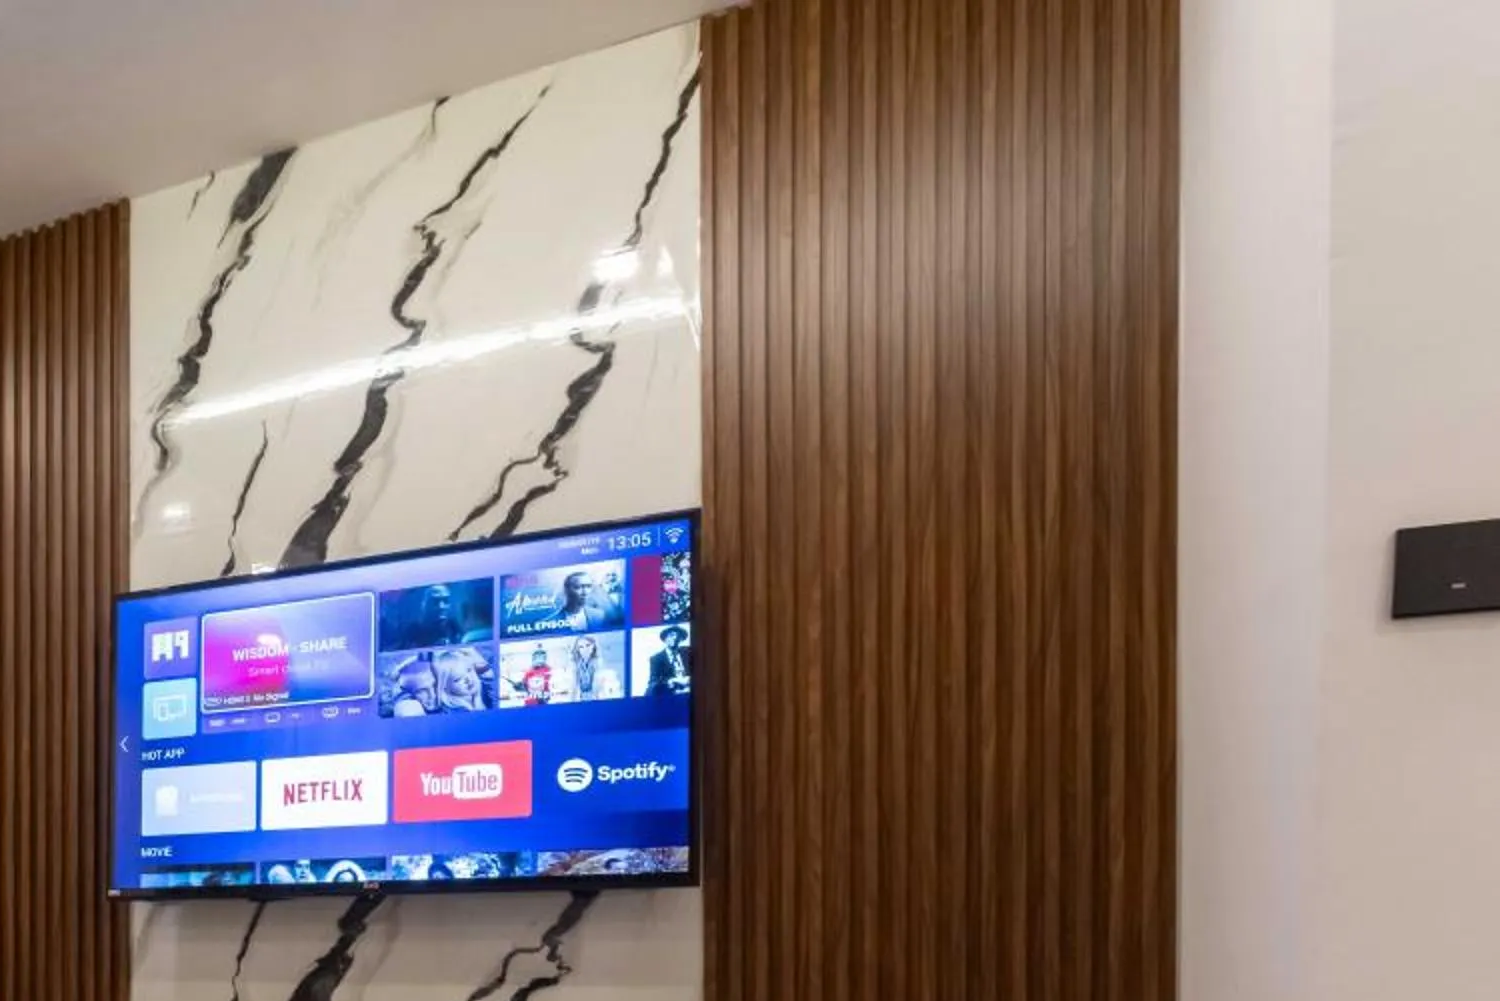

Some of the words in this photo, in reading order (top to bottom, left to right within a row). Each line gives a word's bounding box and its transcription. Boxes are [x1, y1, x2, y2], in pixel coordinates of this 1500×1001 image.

[607, 531, 652, 551] 13:05
[507, 622, 533, 634] FULL
[231, 645, 289, 662] WISDOM
[299, 636, 348, 653] SHARE
[141, 750, 164, 761] HOT
[165, 748, 185, 760] APP
[282, 778, 363, 807] NETFLIX
[419, 766, 500, 797] YouTube
[596, 760, 668, 783] Spotify
[140, 846, 173, 858] MOVIE
